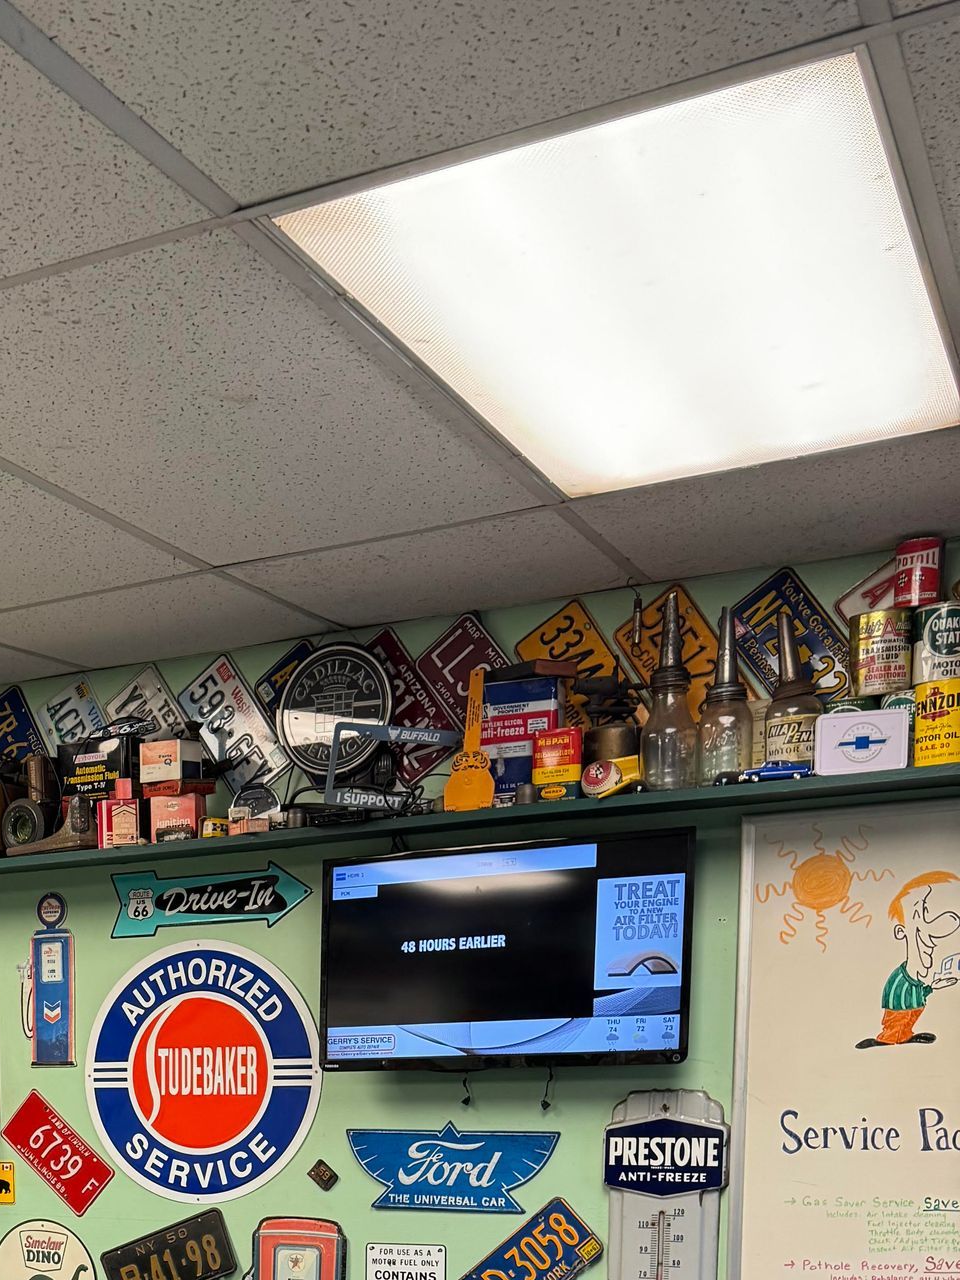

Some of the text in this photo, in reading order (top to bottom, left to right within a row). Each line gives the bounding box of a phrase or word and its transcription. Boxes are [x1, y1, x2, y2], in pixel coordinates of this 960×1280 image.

[867, 666, 890, 674] SEALER
[942, 668, 957, 676] OIL
[295, 661, 374, 700] CADILLAC
[399, 665, 437, 720] ARIZONA
[492, 703, 529, 711] GOVERNMENT
[401, 732, 440, 742] BUFFALO
[769, 745, 800, 756] MOTOR
[75, 764, 106, 775] Automatic
[64, 771, 119, 785] Transmission Fluid
[336, 793, 341, 803] I
[343, 793, 401, 808] SUPPORT
[614, 879, 680, 901] TREAT
[163, 880, 275, 916] Drive-In
[614, 898, 679, 910] YOUR ENGINE
[133, 905, 149, 918] 66
[614, 913, 678, 926] AIR FILTER
[612, 923, 678, 941] TODAY!
[401, 934, 506, 953] 48 HOURS EARLIER
[120, 956, 284, 1028] AUTHORIZED
[328, 1036, 392, 1045] GERRY'S SERVICE
[780, 1109, 901, 1155] Service
[29, 1125, 82, 1180] 6739
[608, 1137, 720, 1167] PRESTONE
[124, 1131, 278, 1190] SERVICE
[397, 1140, 503, 1188] Ford
[619, 1172, 707, 1183] ANTI-FREEZE
[389, 1194, 506, 1207] THE UNIVERSAL CAR
[802, 1196, 960, 1211] Gas Saver Save
[913, 1210, 947, 1219] cleaning
[888, 1221, 921, 1229] Injector
[925, 1221, 955, 1229] cleaning
[24, 1235, 64, 1251] Sinclair
[136, 1240, 156, 1256] NY
[26, 1252, 61, 1265] DINO
[414, 1249, 424, 1257] AS
[426, 1249, 432, 1257] A
[372, 1258, 440, 1267] MOTOR FUEL ONLY
[803, 1256, 960, 1273] Pothole Recovery, Save
